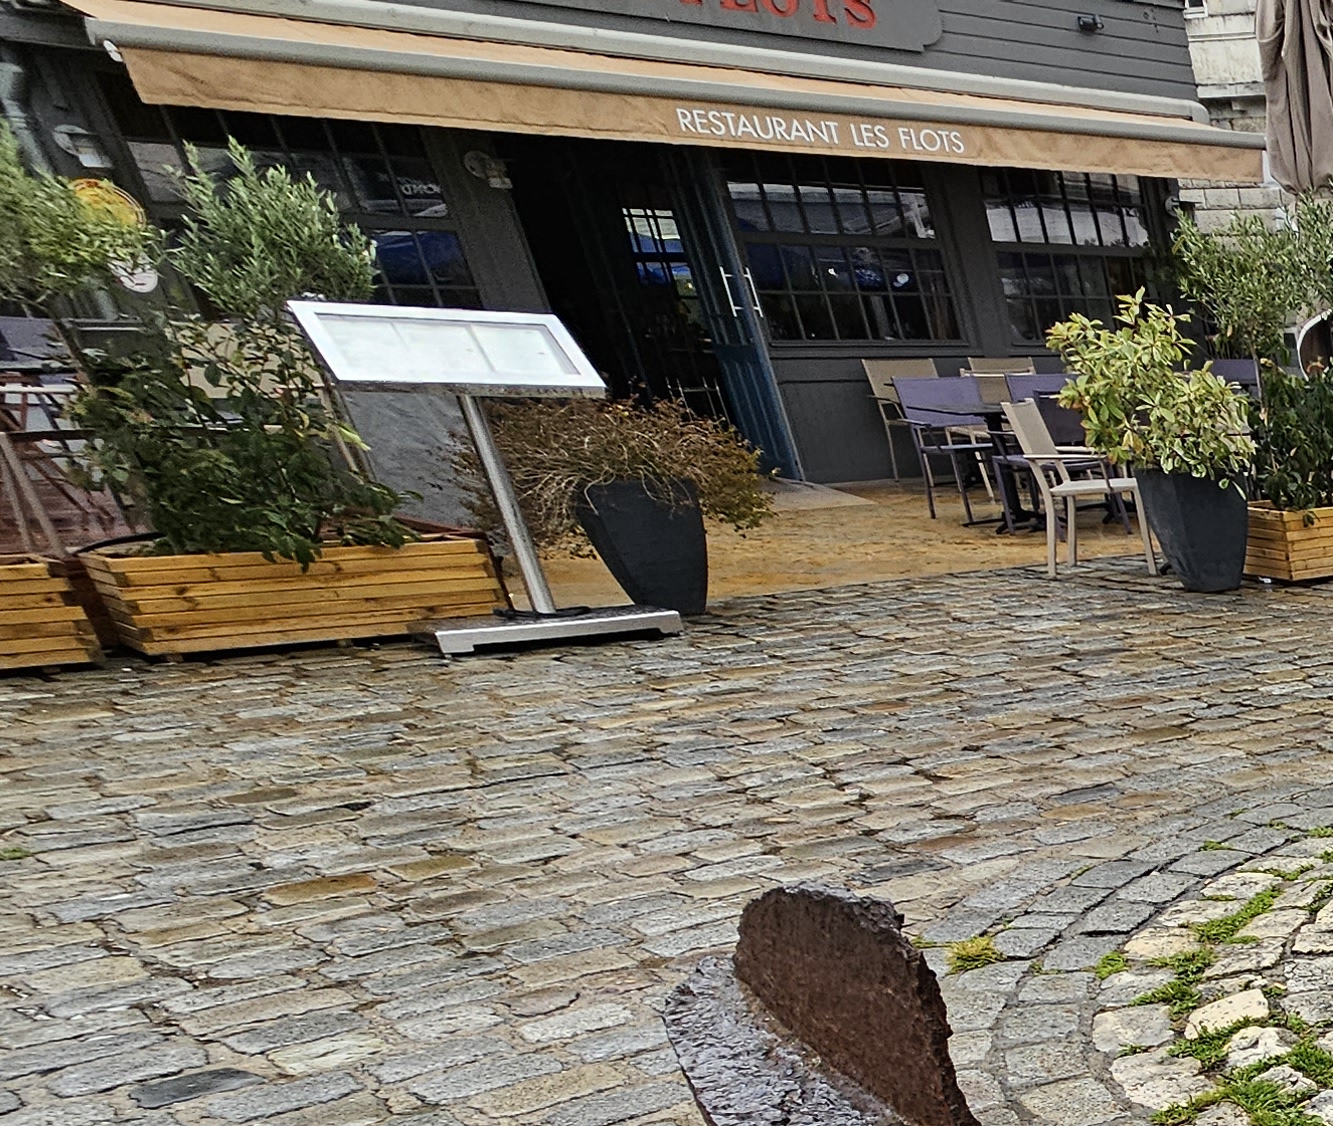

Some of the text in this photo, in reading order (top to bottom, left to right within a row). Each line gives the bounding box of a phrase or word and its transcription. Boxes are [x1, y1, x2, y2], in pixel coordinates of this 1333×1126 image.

[676, 107, 965, 154] RESTAURANT LES FLOTS
